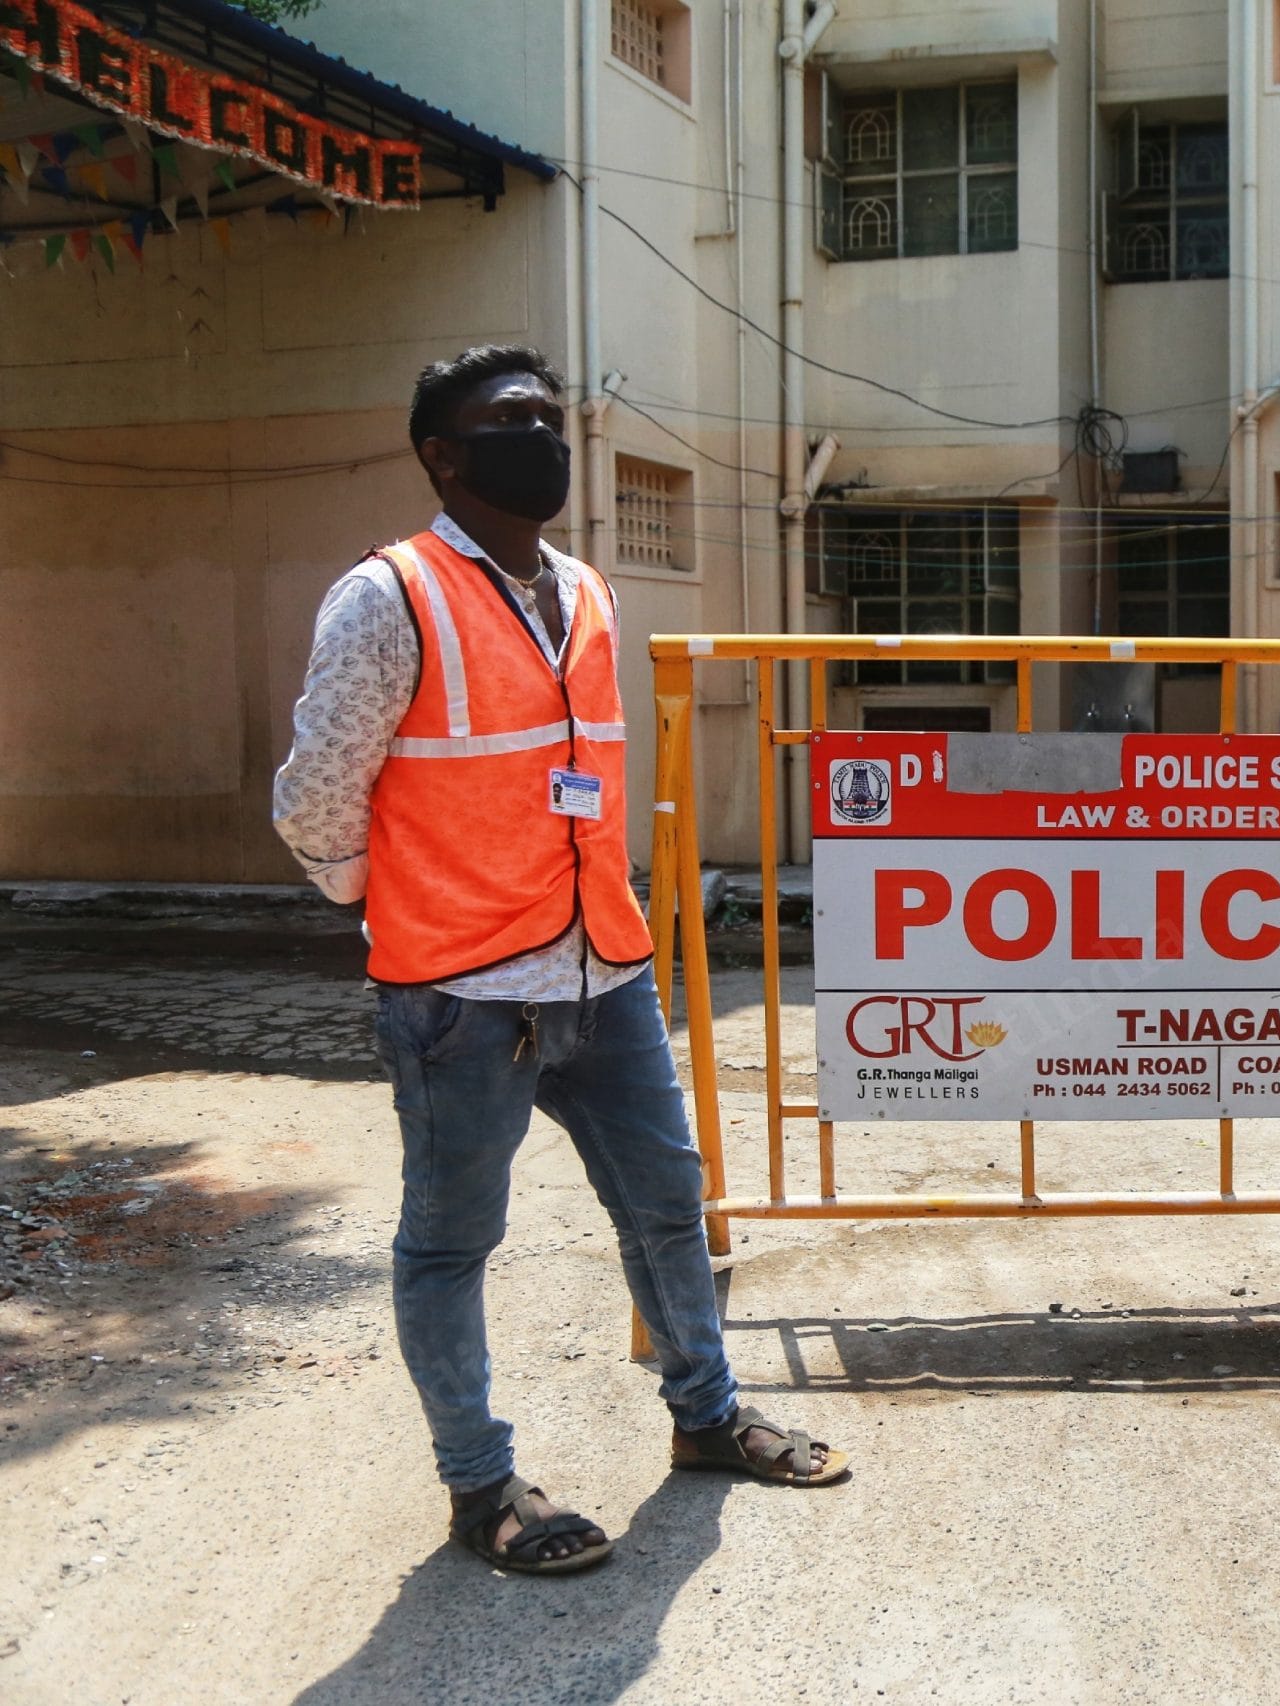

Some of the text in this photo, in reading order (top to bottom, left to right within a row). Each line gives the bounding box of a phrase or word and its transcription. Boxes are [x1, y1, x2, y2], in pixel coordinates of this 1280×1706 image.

[1136, 755, 1259, 790] POLICE
[1037, 805, 1280, 829] LAW & ORDER
[846, 996, 987, 1062] GRT
[1036, 1057, 1207, 1075] USMAN ROAD
[857, 1085, 980, 1099] JEWELLERS
[1072, 1083, 1106, 1096] 044
[1117, 1083, 1161, 1096] 2434
[1167, 1082, 1211, 1096] 5062
